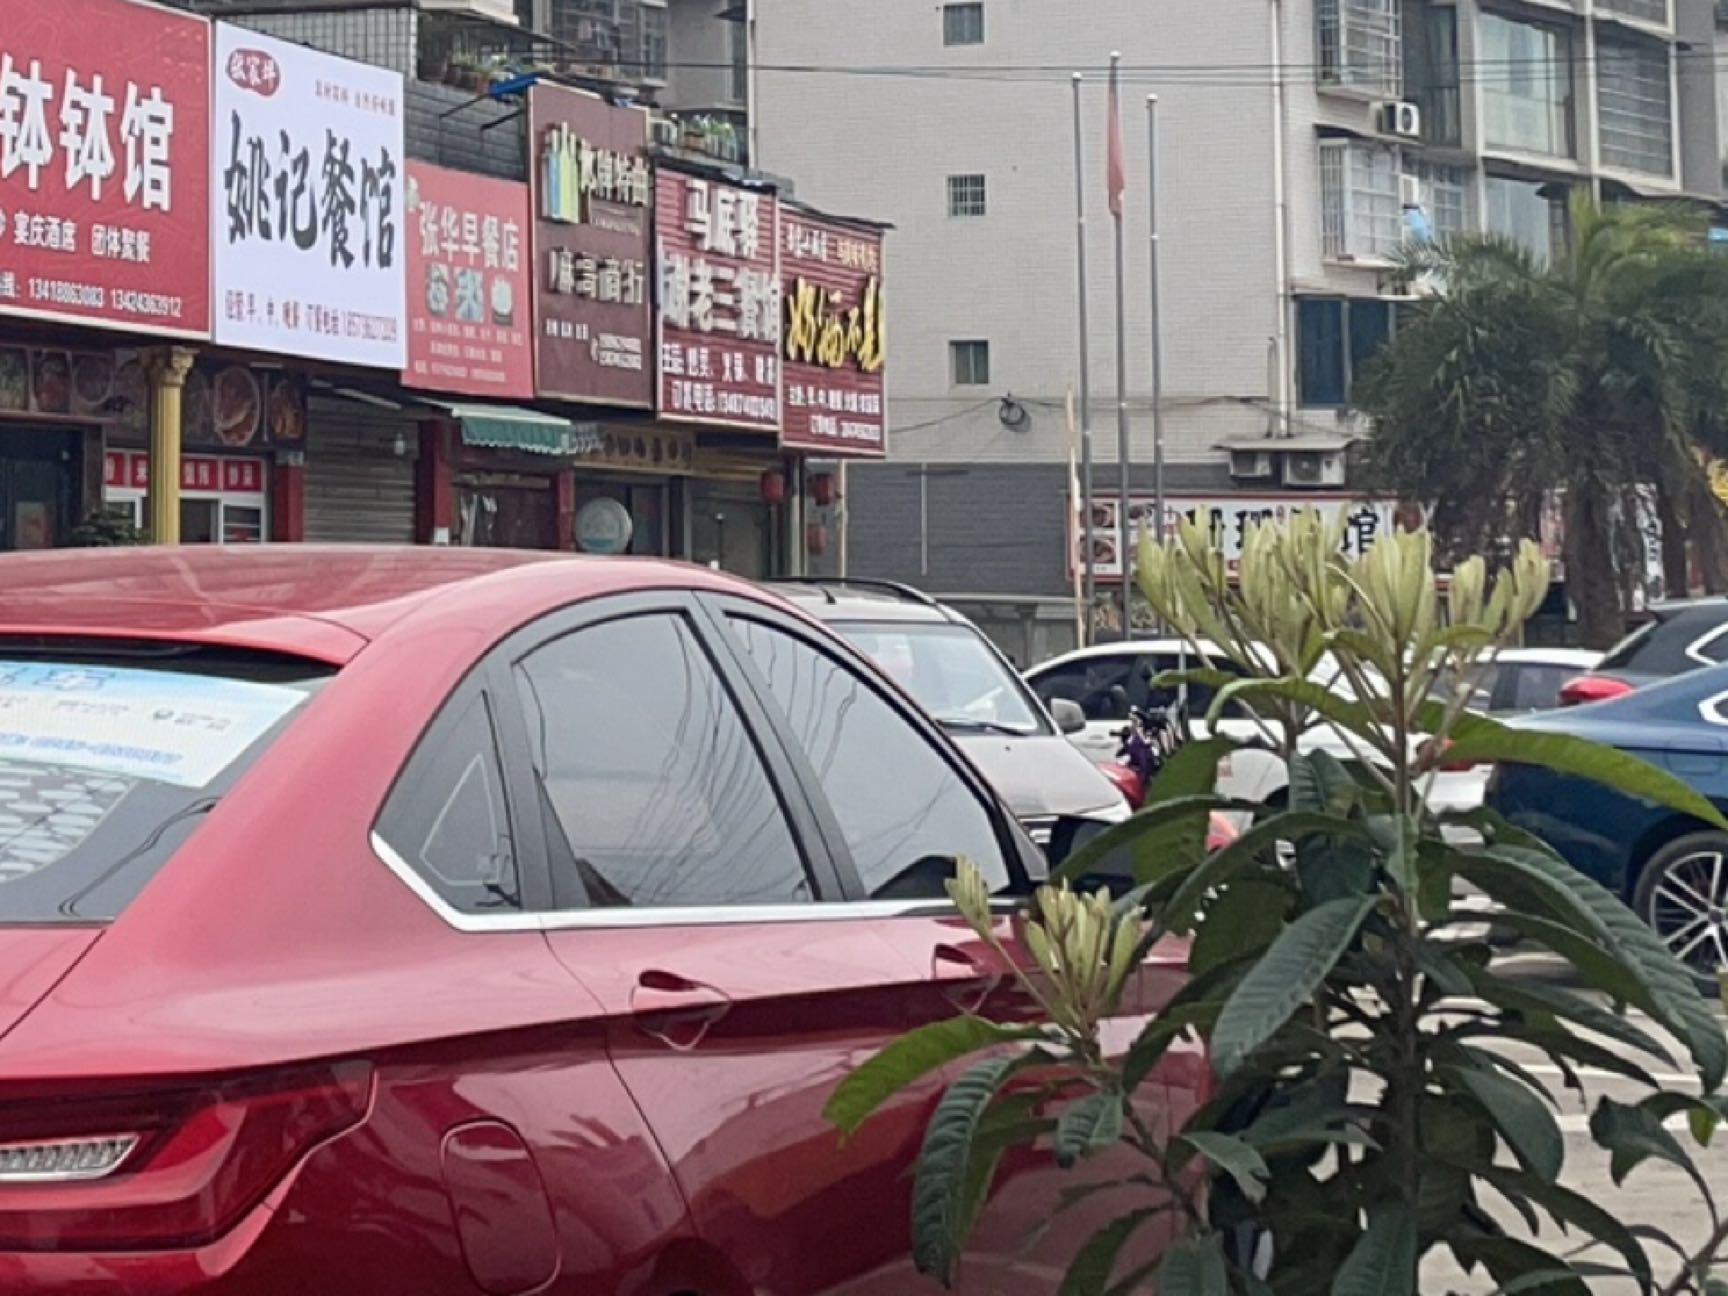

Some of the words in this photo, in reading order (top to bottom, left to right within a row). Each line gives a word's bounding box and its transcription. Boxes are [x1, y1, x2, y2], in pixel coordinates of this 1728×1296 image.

[224, 109, 396, 268] 姚记餐馆
[419, 201, 519, 272] 张华早餐店
